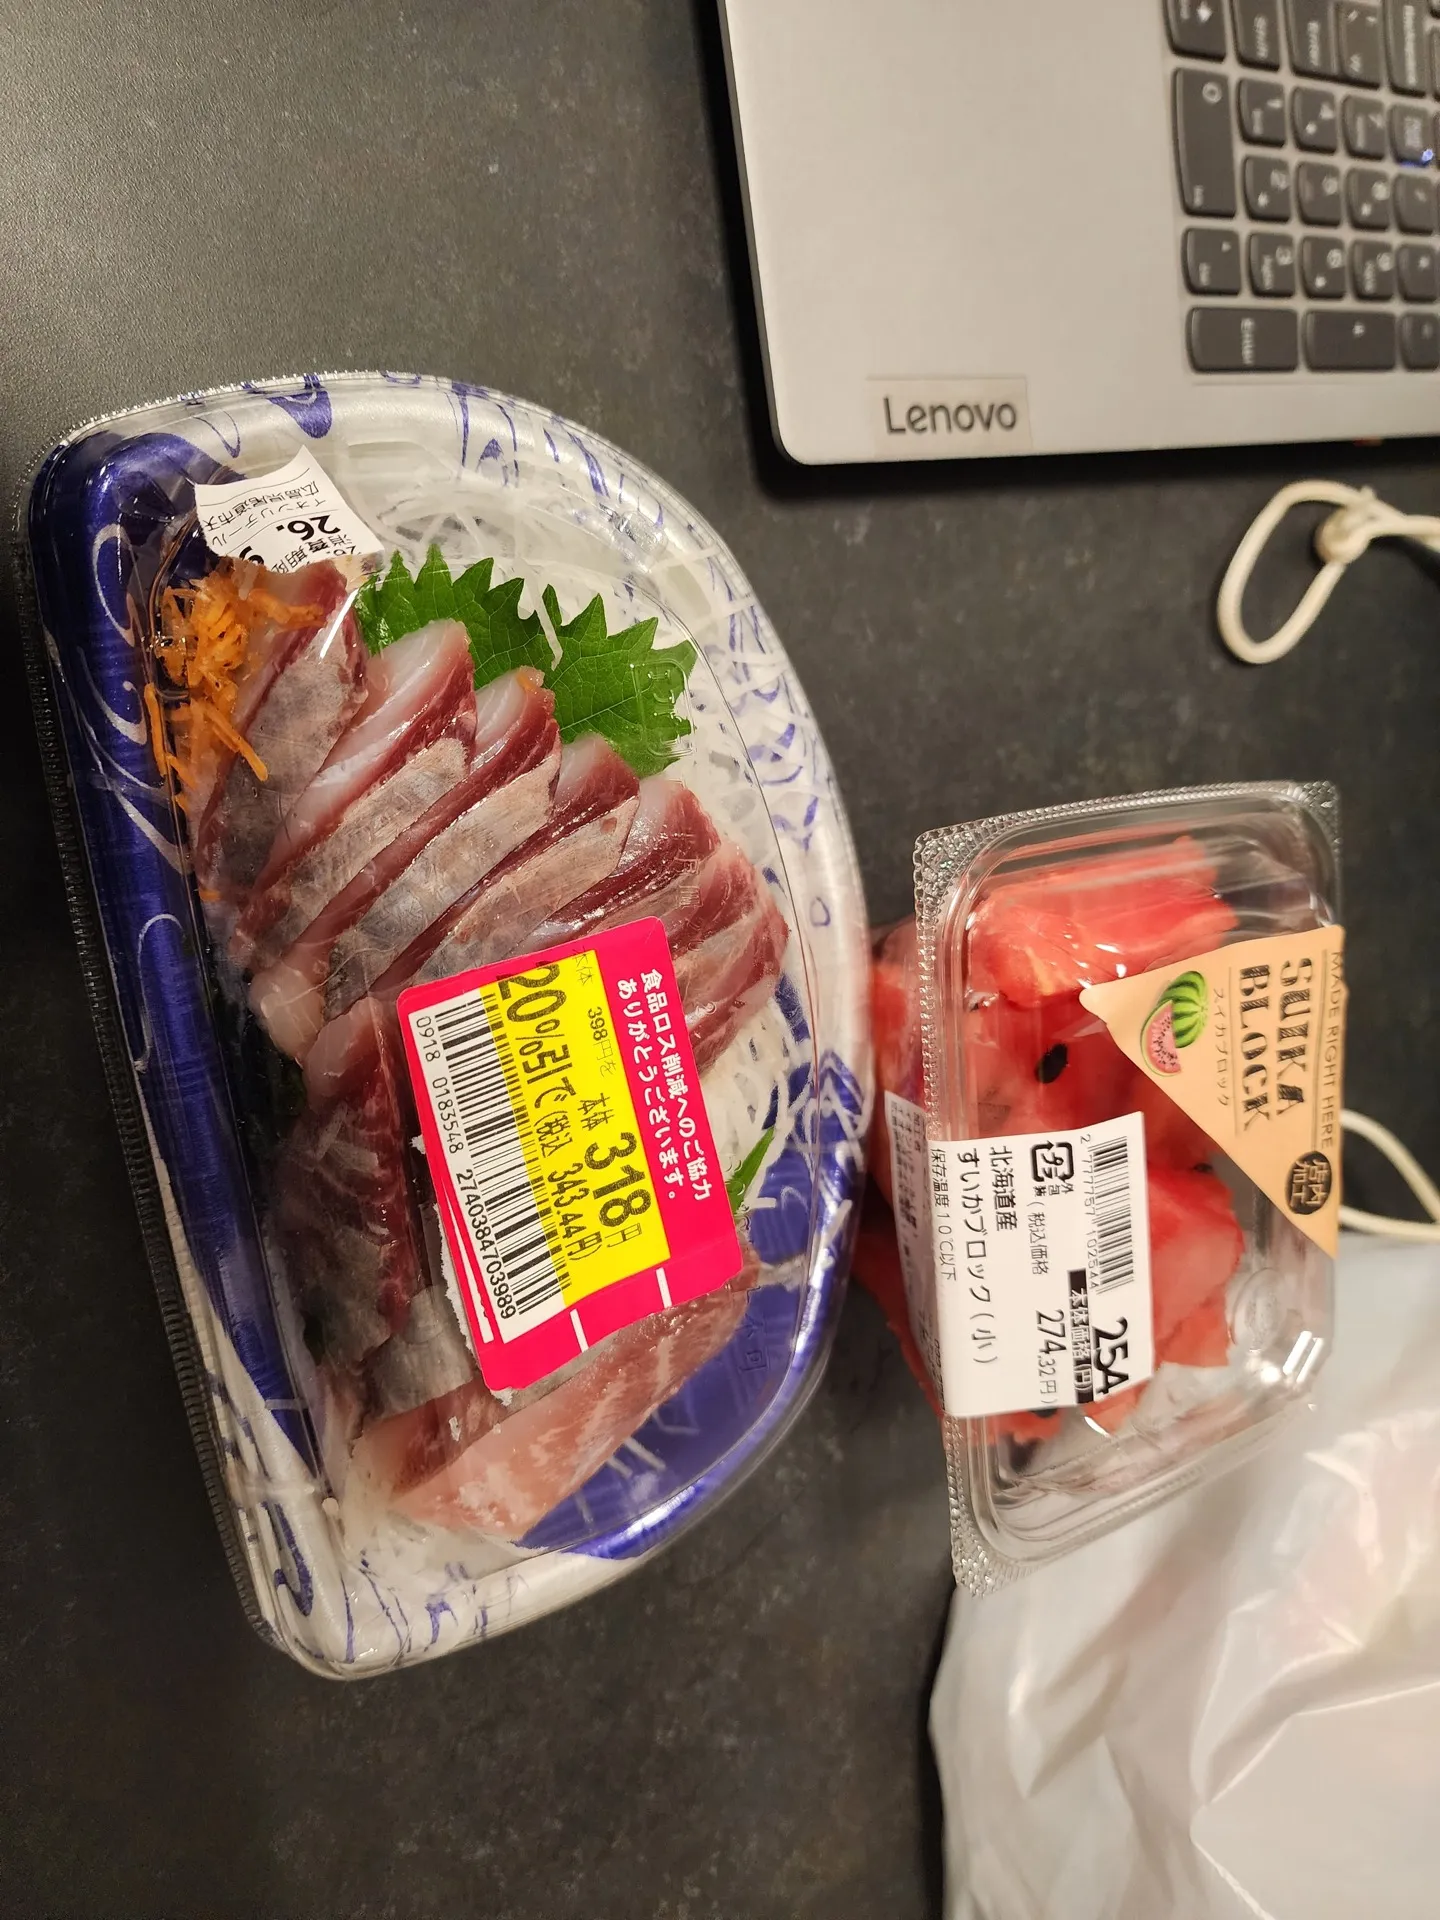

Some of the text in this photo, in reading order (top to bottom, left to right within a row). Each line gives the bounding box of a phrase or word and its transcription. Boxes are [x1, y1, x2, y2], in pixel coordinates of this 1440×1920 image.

[883, 396, 1017, 434] Lenovo
[202, 480, 320, 532] 広島県尾道市天
[211, 498, 327, 548] イオンリテール
[276, 514, 341, 541] 26.
[496, 960, 577, 1111] 20%引で
[583, 1131, 652, 1249] 318円
[616, 979, 685, 1201] ありがとうございます。
[640, 968, 711, 1201] 食品ロス削減へのご協力
[1213, 987, 1230, 1107] スイカブロック
[1239, 964, 1271, 1132] BLOCK
[1276, 957, 1314, 1115] SUIKA
[1320, 951, 1345, 1149] MADE RIGHT HERE
[415, 1015, 517, 1321] 0918 0183548 2740384703989
[989, 1145, 1018, 1231] 北海道産
[1080, 1133, 1101, 1290] 2 777757 102544
[1290, 1159, 1309, 1208] 加工
[1306, 1158, 1329, 1205] 店内
[956, 1147, 999, 1364] すいかブロック(小)
